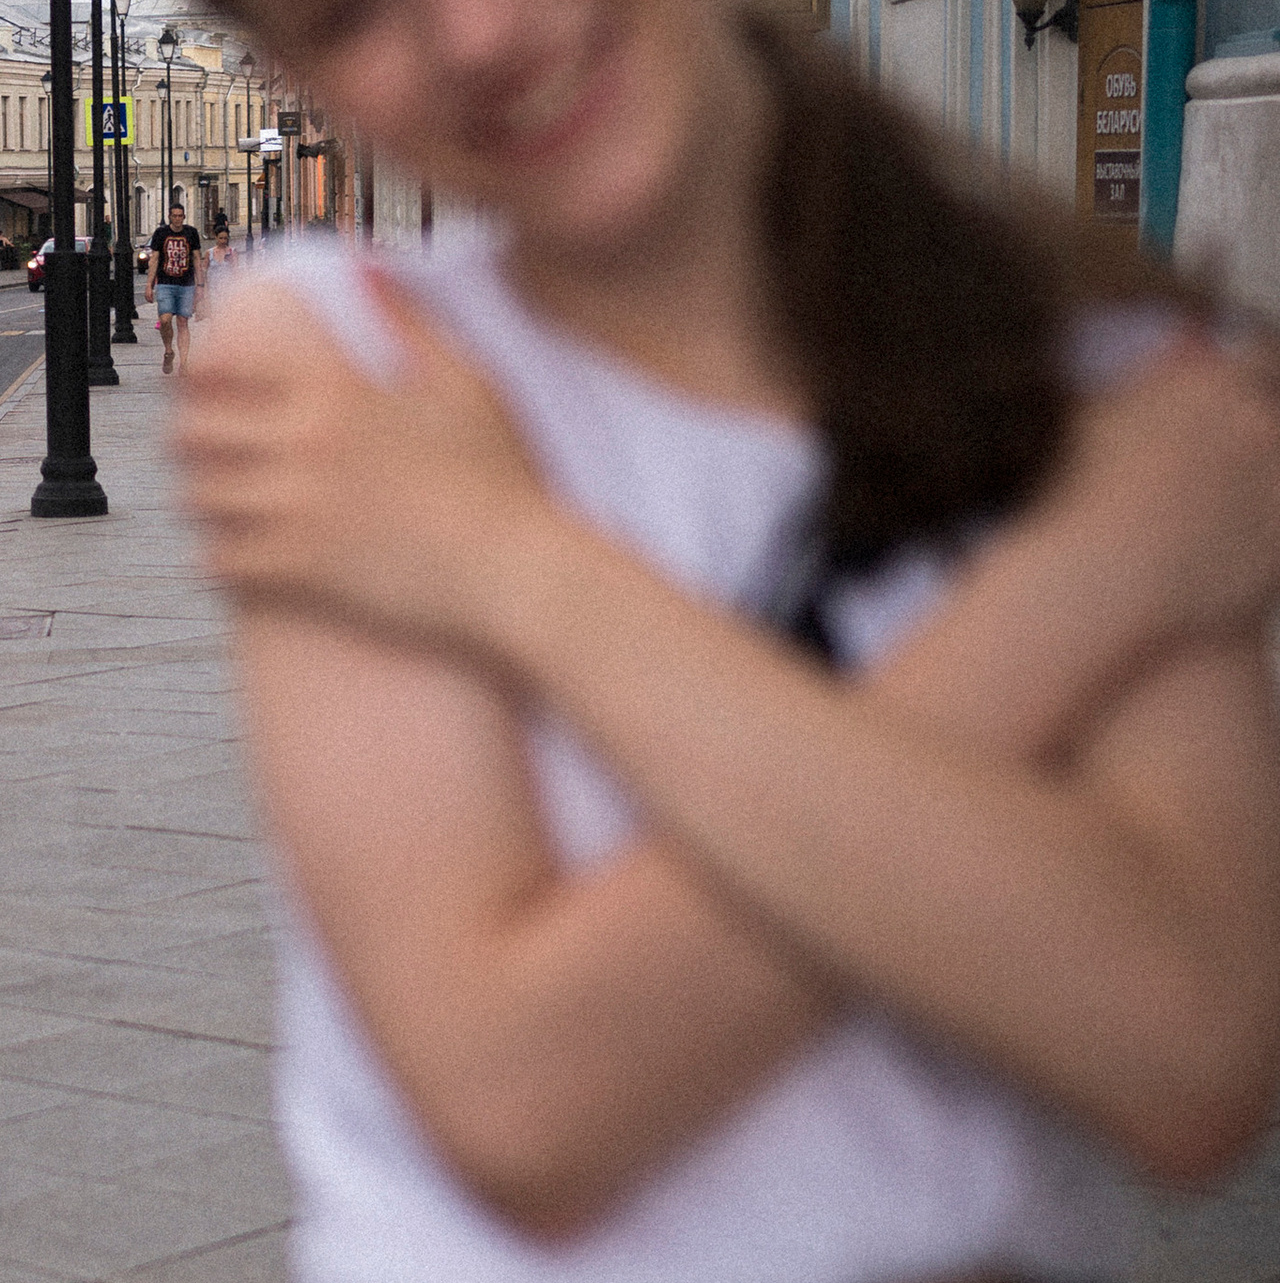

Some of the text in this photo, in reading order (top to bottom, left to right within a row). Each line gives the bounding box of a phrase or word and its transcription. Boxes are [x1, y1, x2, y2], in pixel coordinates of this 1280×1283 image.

[1106, 73, 1136, 97] ОБУВЬ
[1110, 183, 1125, 200] ЗАЛ
[167, 240, 185, 250] ALL
[167, 250, 186, 258] TOG
